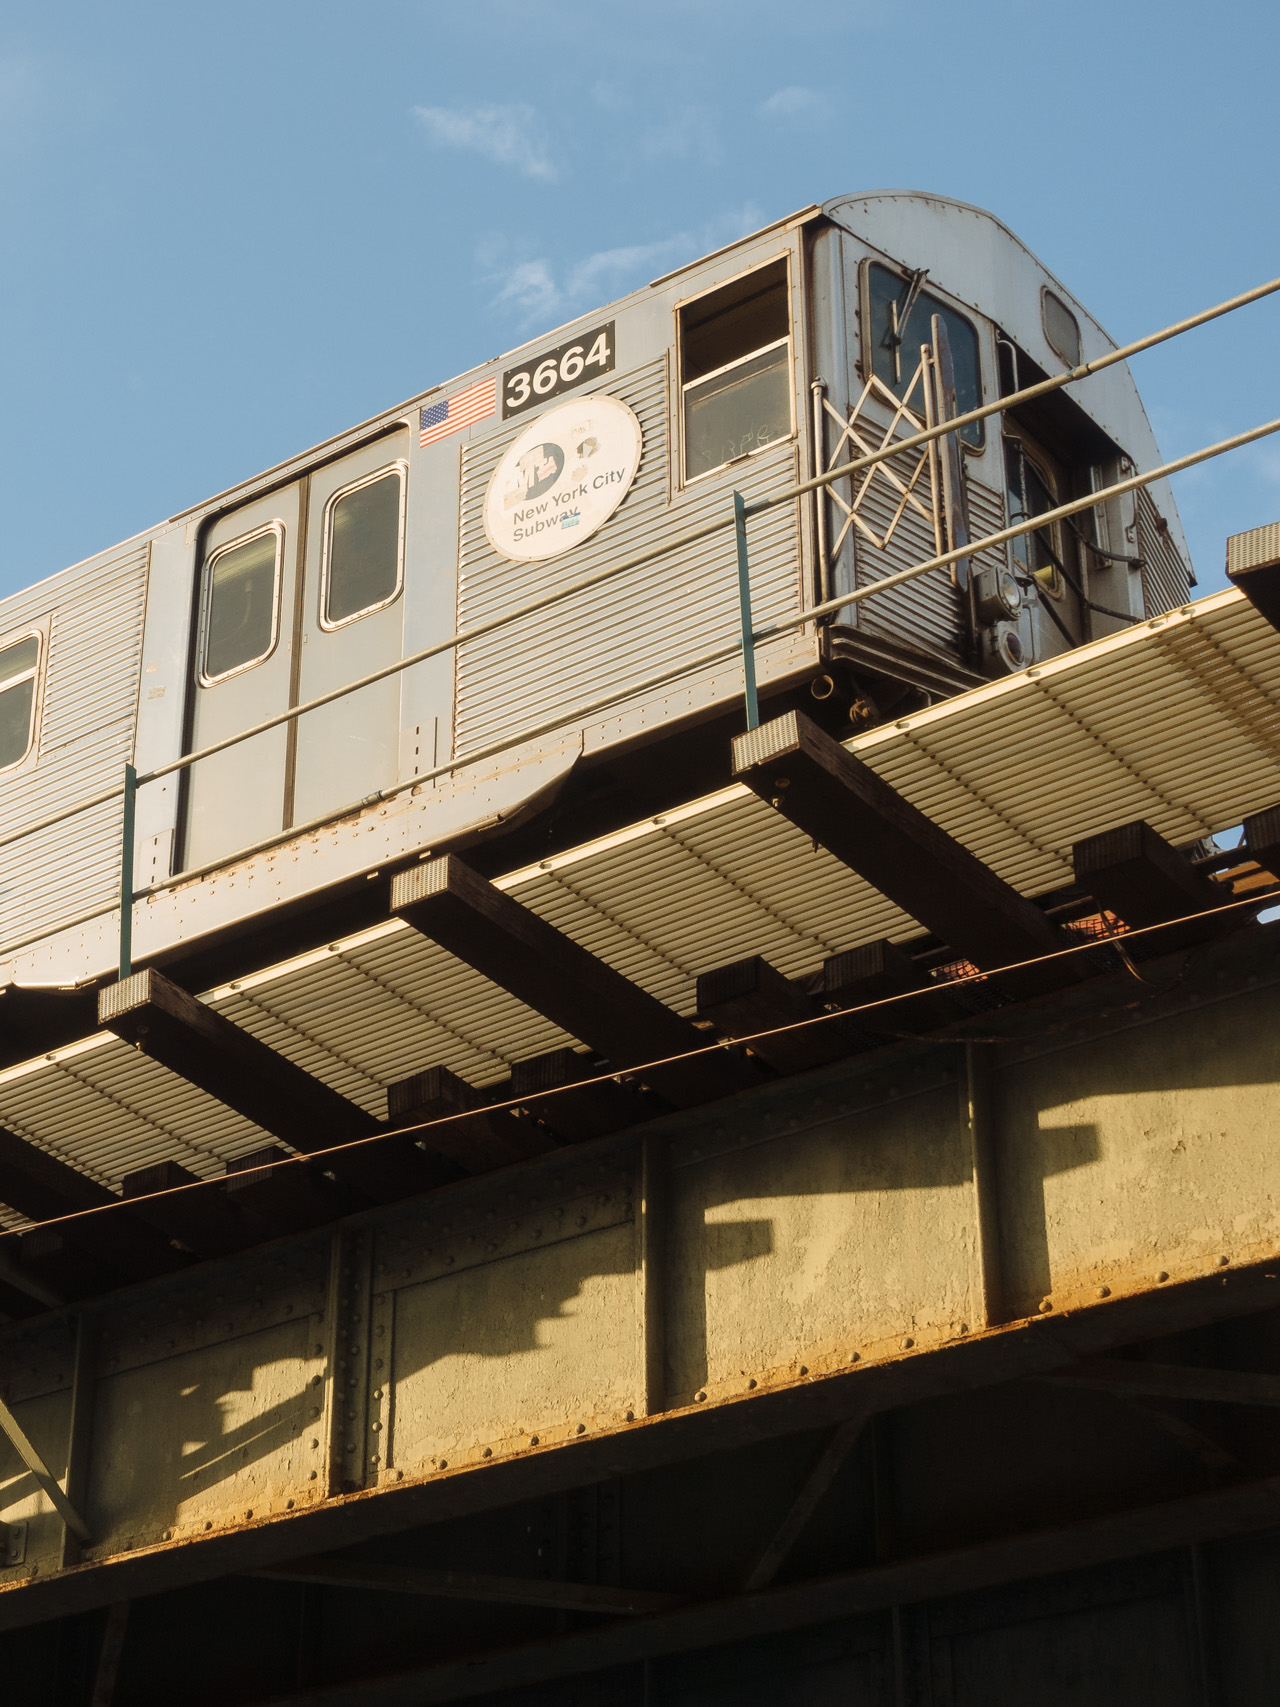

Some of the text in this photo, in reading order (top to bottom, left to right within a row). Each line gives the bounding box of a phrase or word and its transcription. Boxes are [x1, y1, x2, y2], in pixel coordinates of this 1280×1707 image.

[505, 331, 611, 409] 3664
[513, 501, 549, 526] New
[552, 484, 589, 507] York
[592, 467, 626, 490] City
[513, 506, 579, 543] Subway
